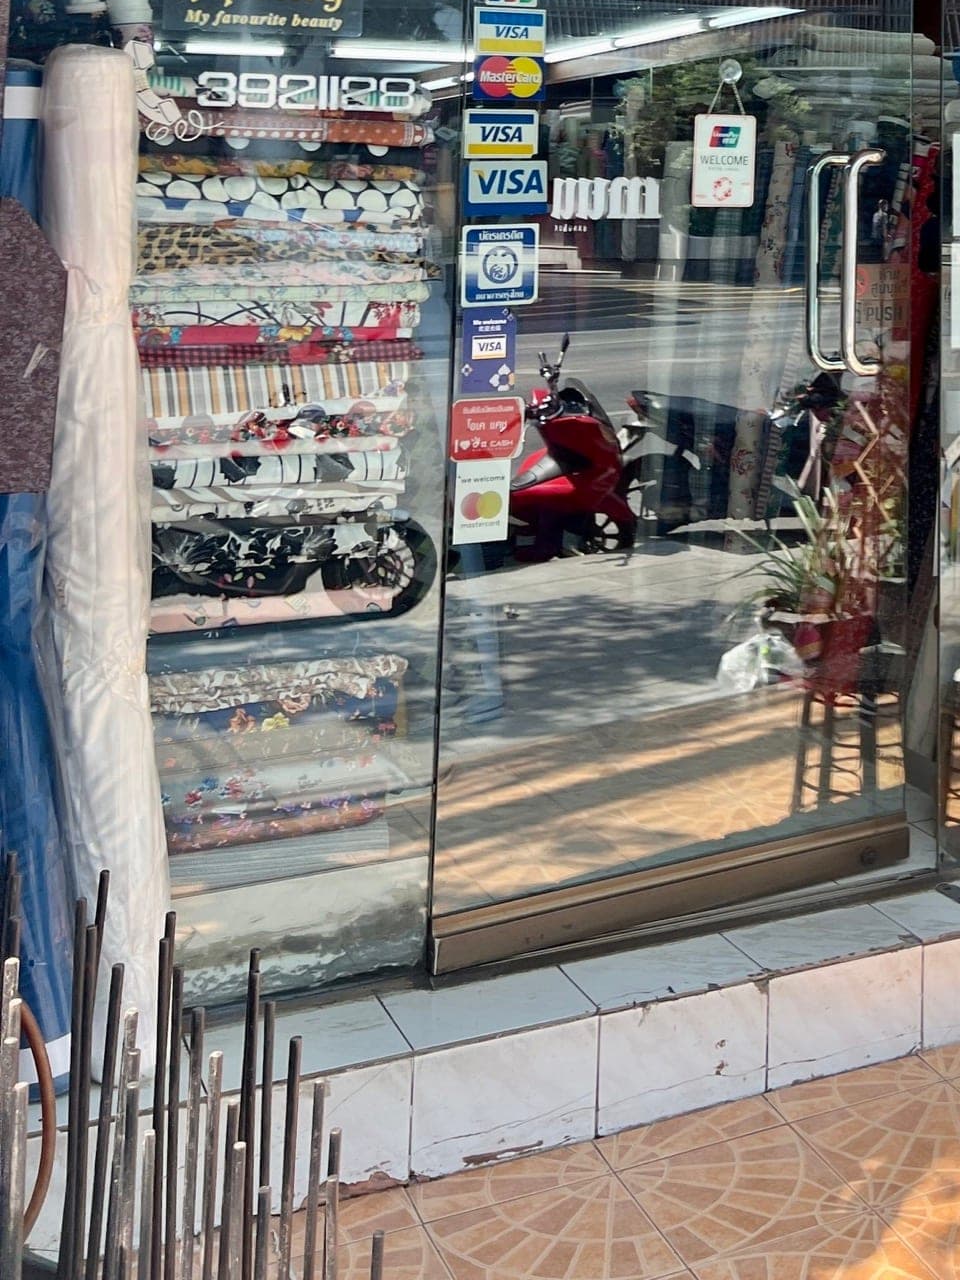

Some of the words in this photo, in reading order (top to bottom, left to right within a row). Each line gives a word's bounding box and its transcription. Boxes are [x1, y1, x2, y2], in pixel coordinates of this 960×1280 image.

[184, 10, 210, 26] My
[212, 10, 287, 26] favourite
[291, 14, 343, 31] beauty
[496, 25, 529, 39] VISA
[479, 70, 540, 83] MasterCard
[197, 70, 417, 114] 3921128
[480, 125, 523, 143] VISA
[699, 154, 750, 166] WELCOME
[473, 168, 544, 195] VISA
[478, 341, 502, 352] VISA
[473, 475, 506, 483] welcome
